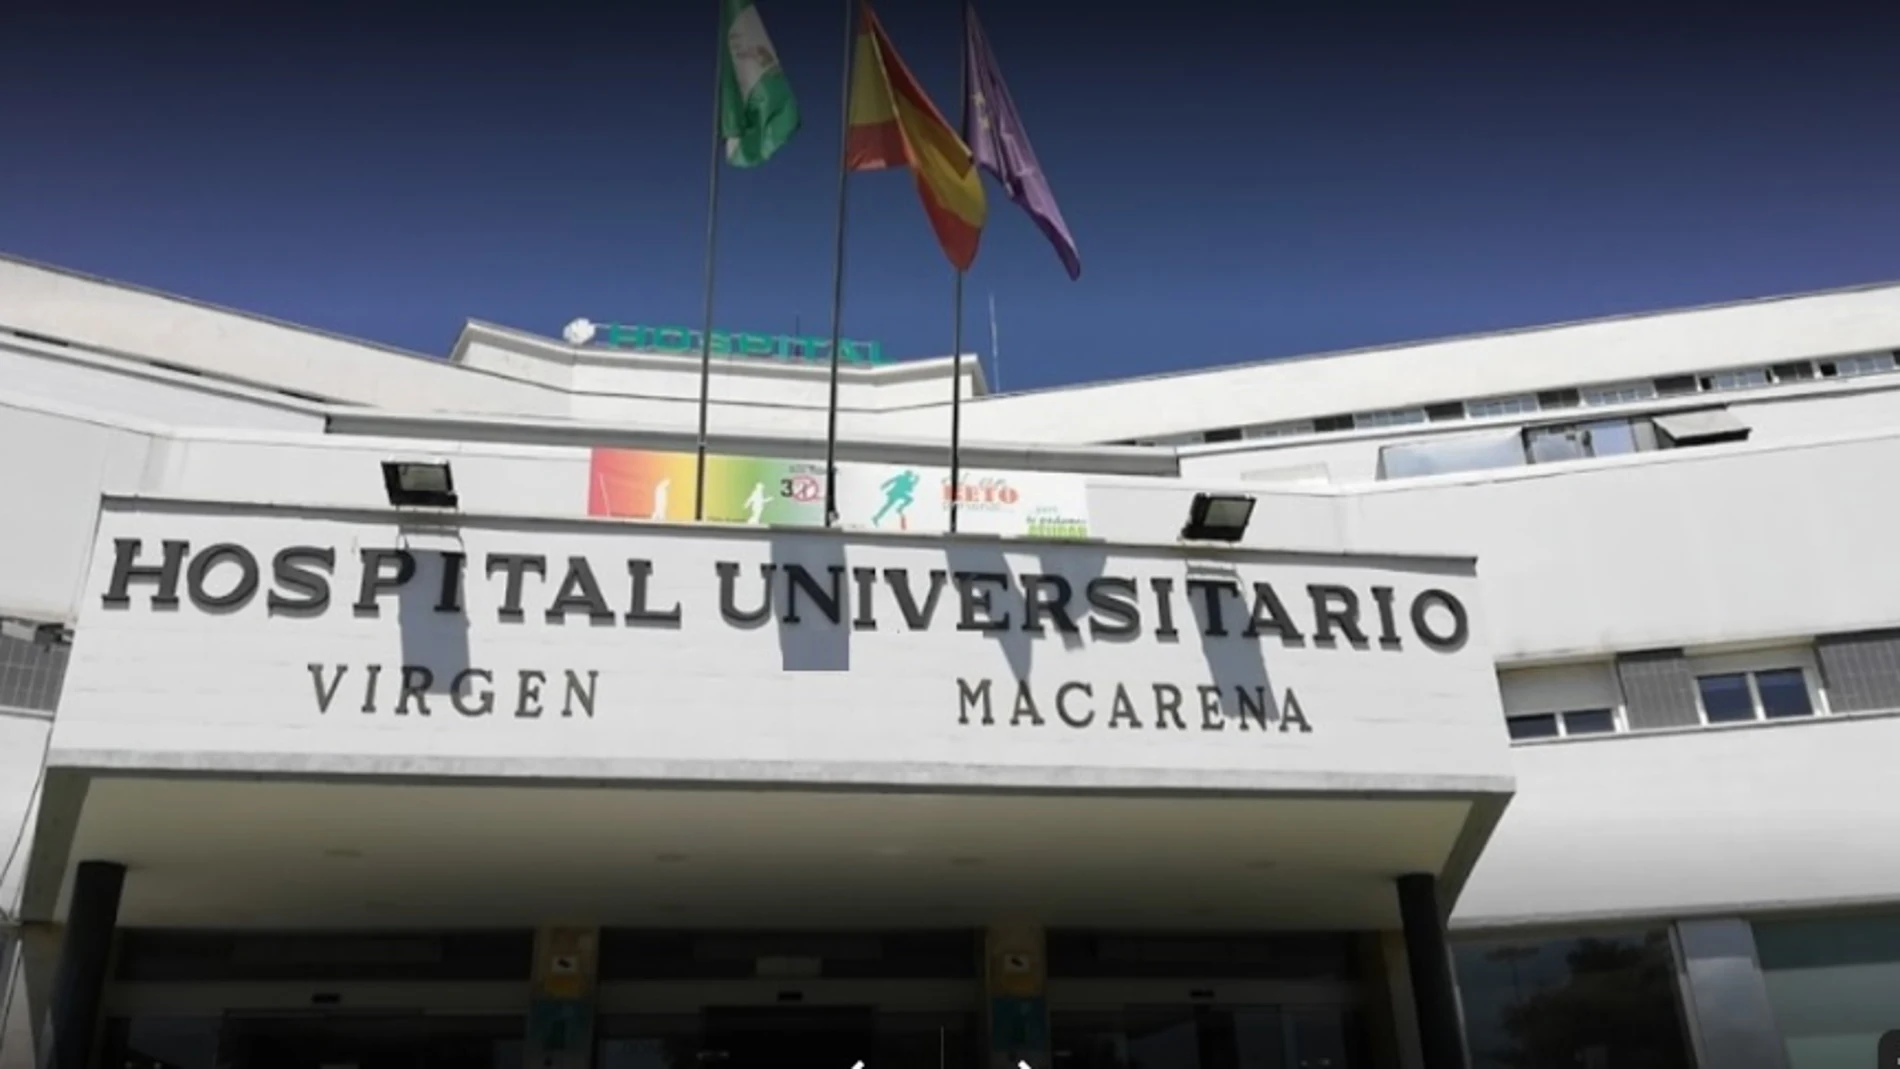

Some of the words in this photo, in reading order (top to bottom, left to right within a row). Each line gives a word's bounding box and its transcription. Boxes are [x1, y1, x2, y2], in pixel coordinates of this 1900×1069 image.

[609, 322, 893, 366] HOSPITAL
[101, 538, 682, 628] HOSPITAL
[716, 560, 1471, 652] UNIVERSITARIO
[307, 664, 600, 718] VIRGEN
[956, 677, 1315, 734] MACARENA
